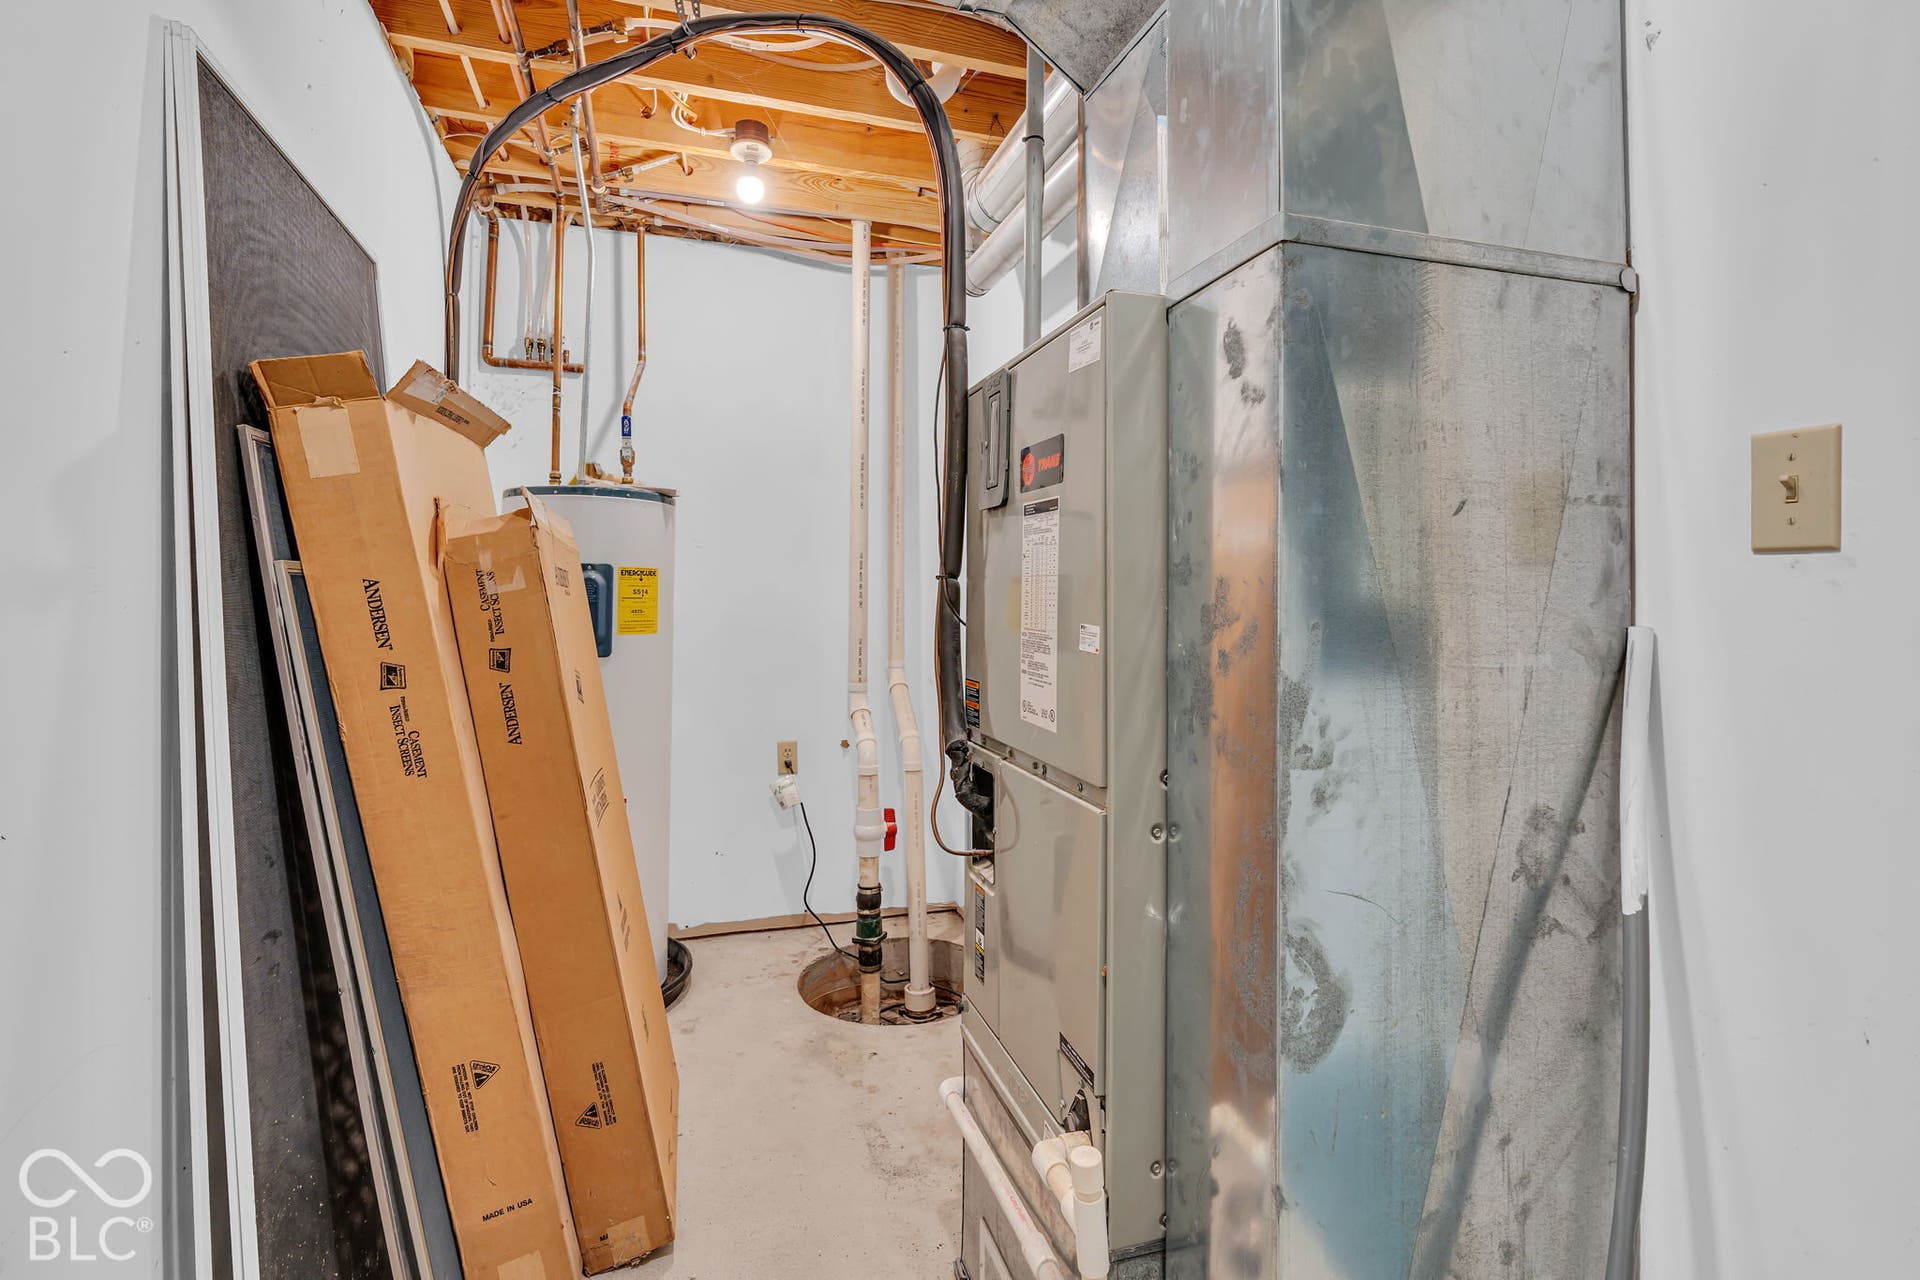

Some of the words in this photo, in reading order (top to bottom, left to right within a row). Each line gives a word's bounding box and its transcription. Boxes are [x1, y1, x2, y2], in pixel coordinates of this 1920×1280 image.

[476, 569, 491, 612] CASEMENT
[490, 608, 505, 635] INSECT
[389, 705, 406, 736] INSECT
[498, 682, 522, 745] ANDERSEN
[397, 737, 415, 777] SCREENS
[407, 730, 428, 778] CASEMENT
[482, 1209, 505, 1222] MADE
[506, 1204, 515, 1213] IN
[517, 1198, 533, 1210] USA
